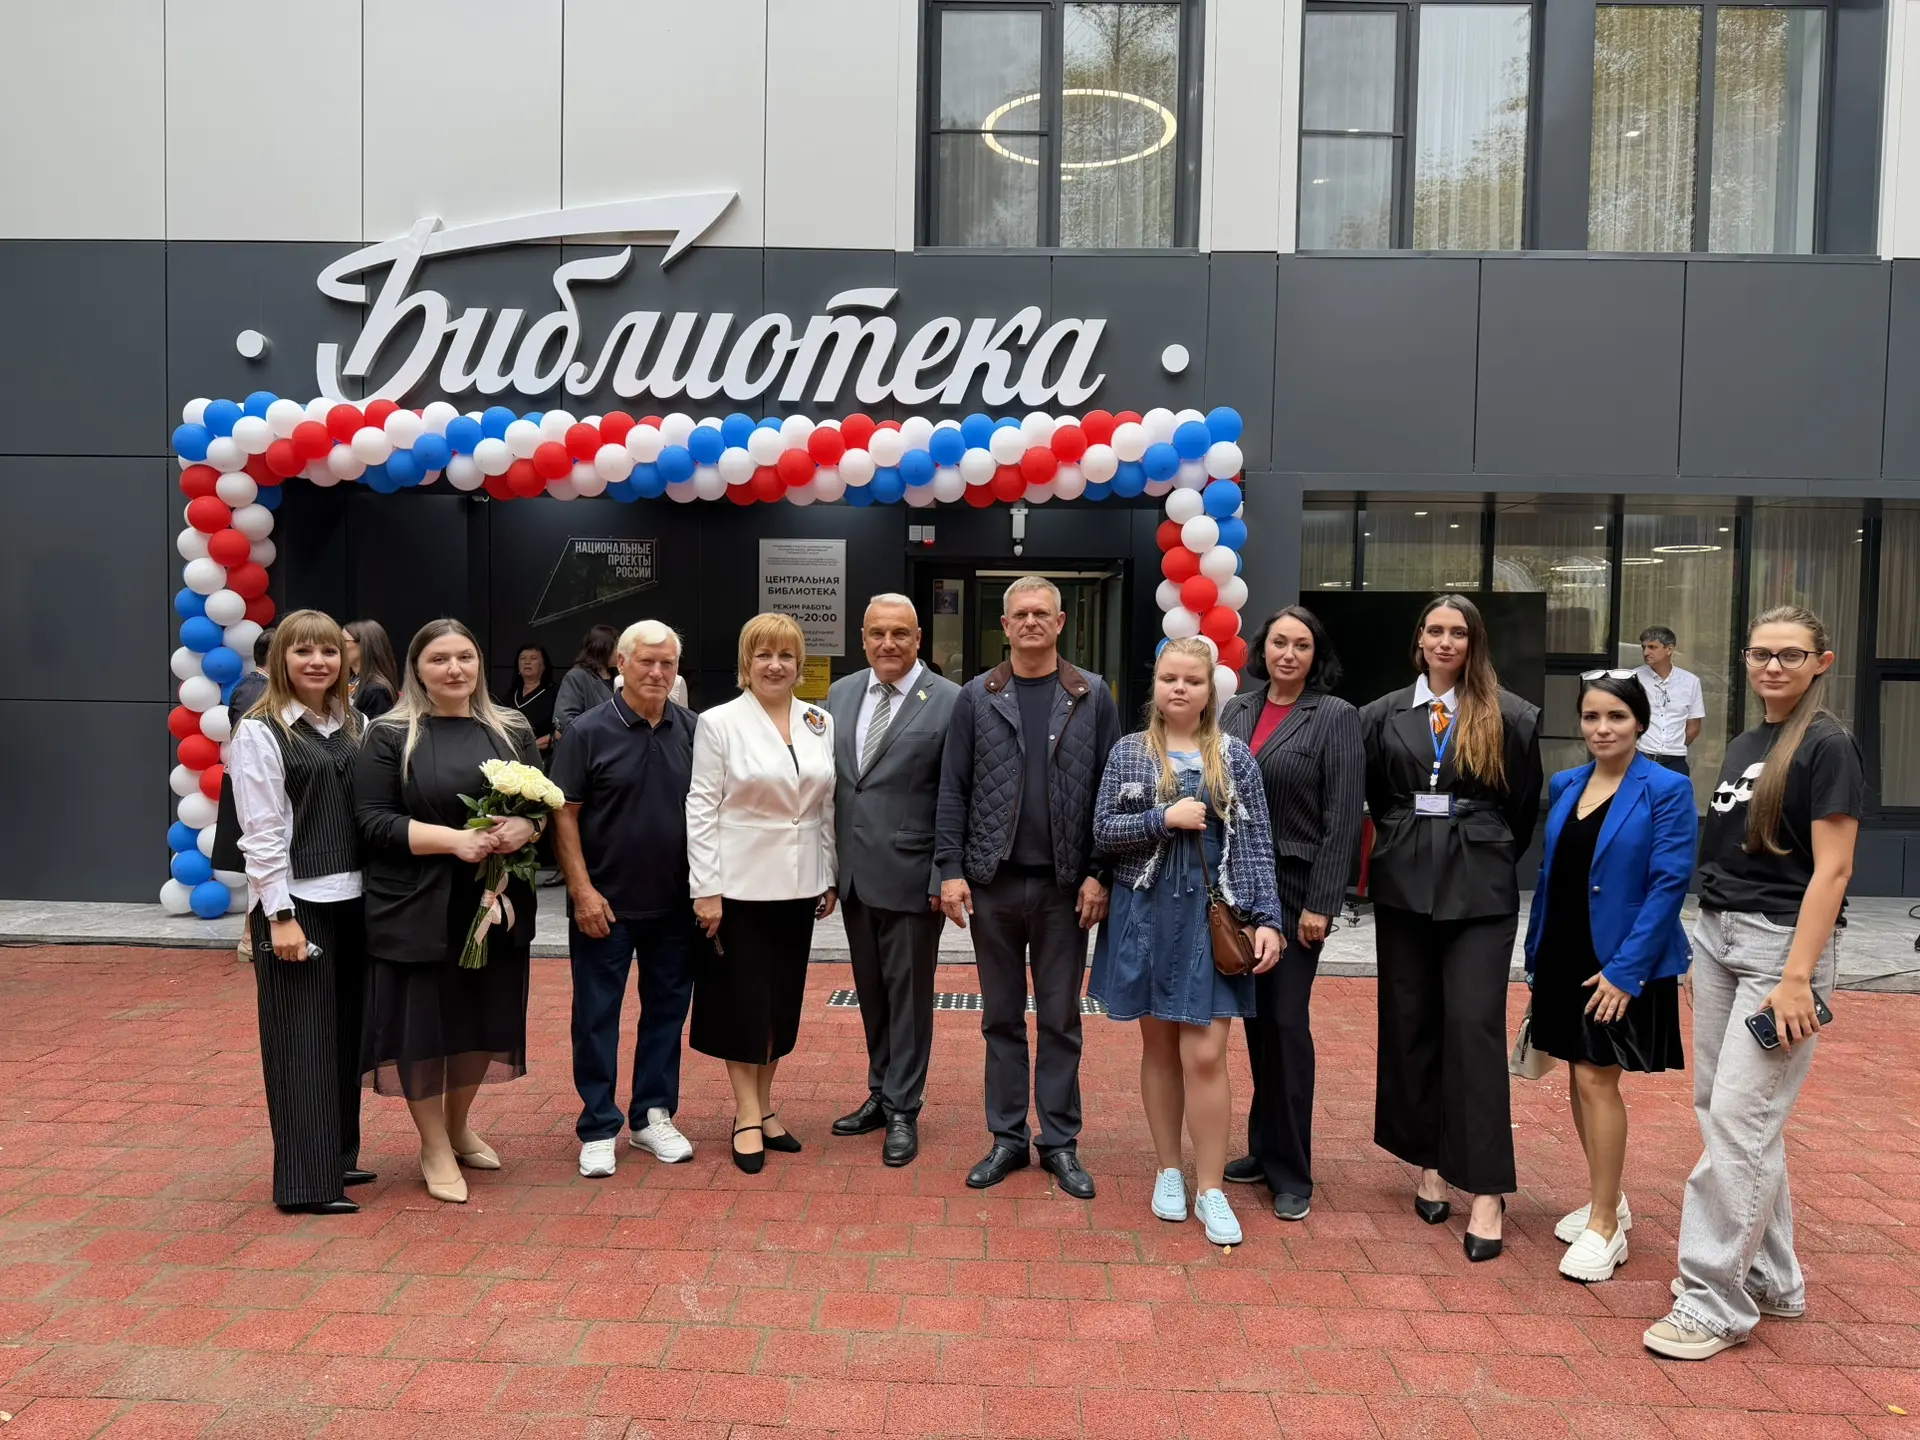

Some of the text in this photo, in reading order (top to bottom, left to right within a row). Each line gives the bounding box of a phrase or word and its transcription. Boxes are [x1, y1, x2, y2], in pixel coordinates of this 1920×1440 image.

[316, 189, 1107, 408] Библиотека
[575, 541, 652, 554] НАЦИОНАЛЬНЫЕ
[607, 554, 652, 566] ПРОЕКТЫ
[615, 566, 652, 578] РОССИИ
[765, 575, 840, 585] ЦЕНТРАЛЬНАЯ
[767, 586, 838, 596] БИБЛИОТЕКА
[772, 603, 801, 611] РЕЖИМ
